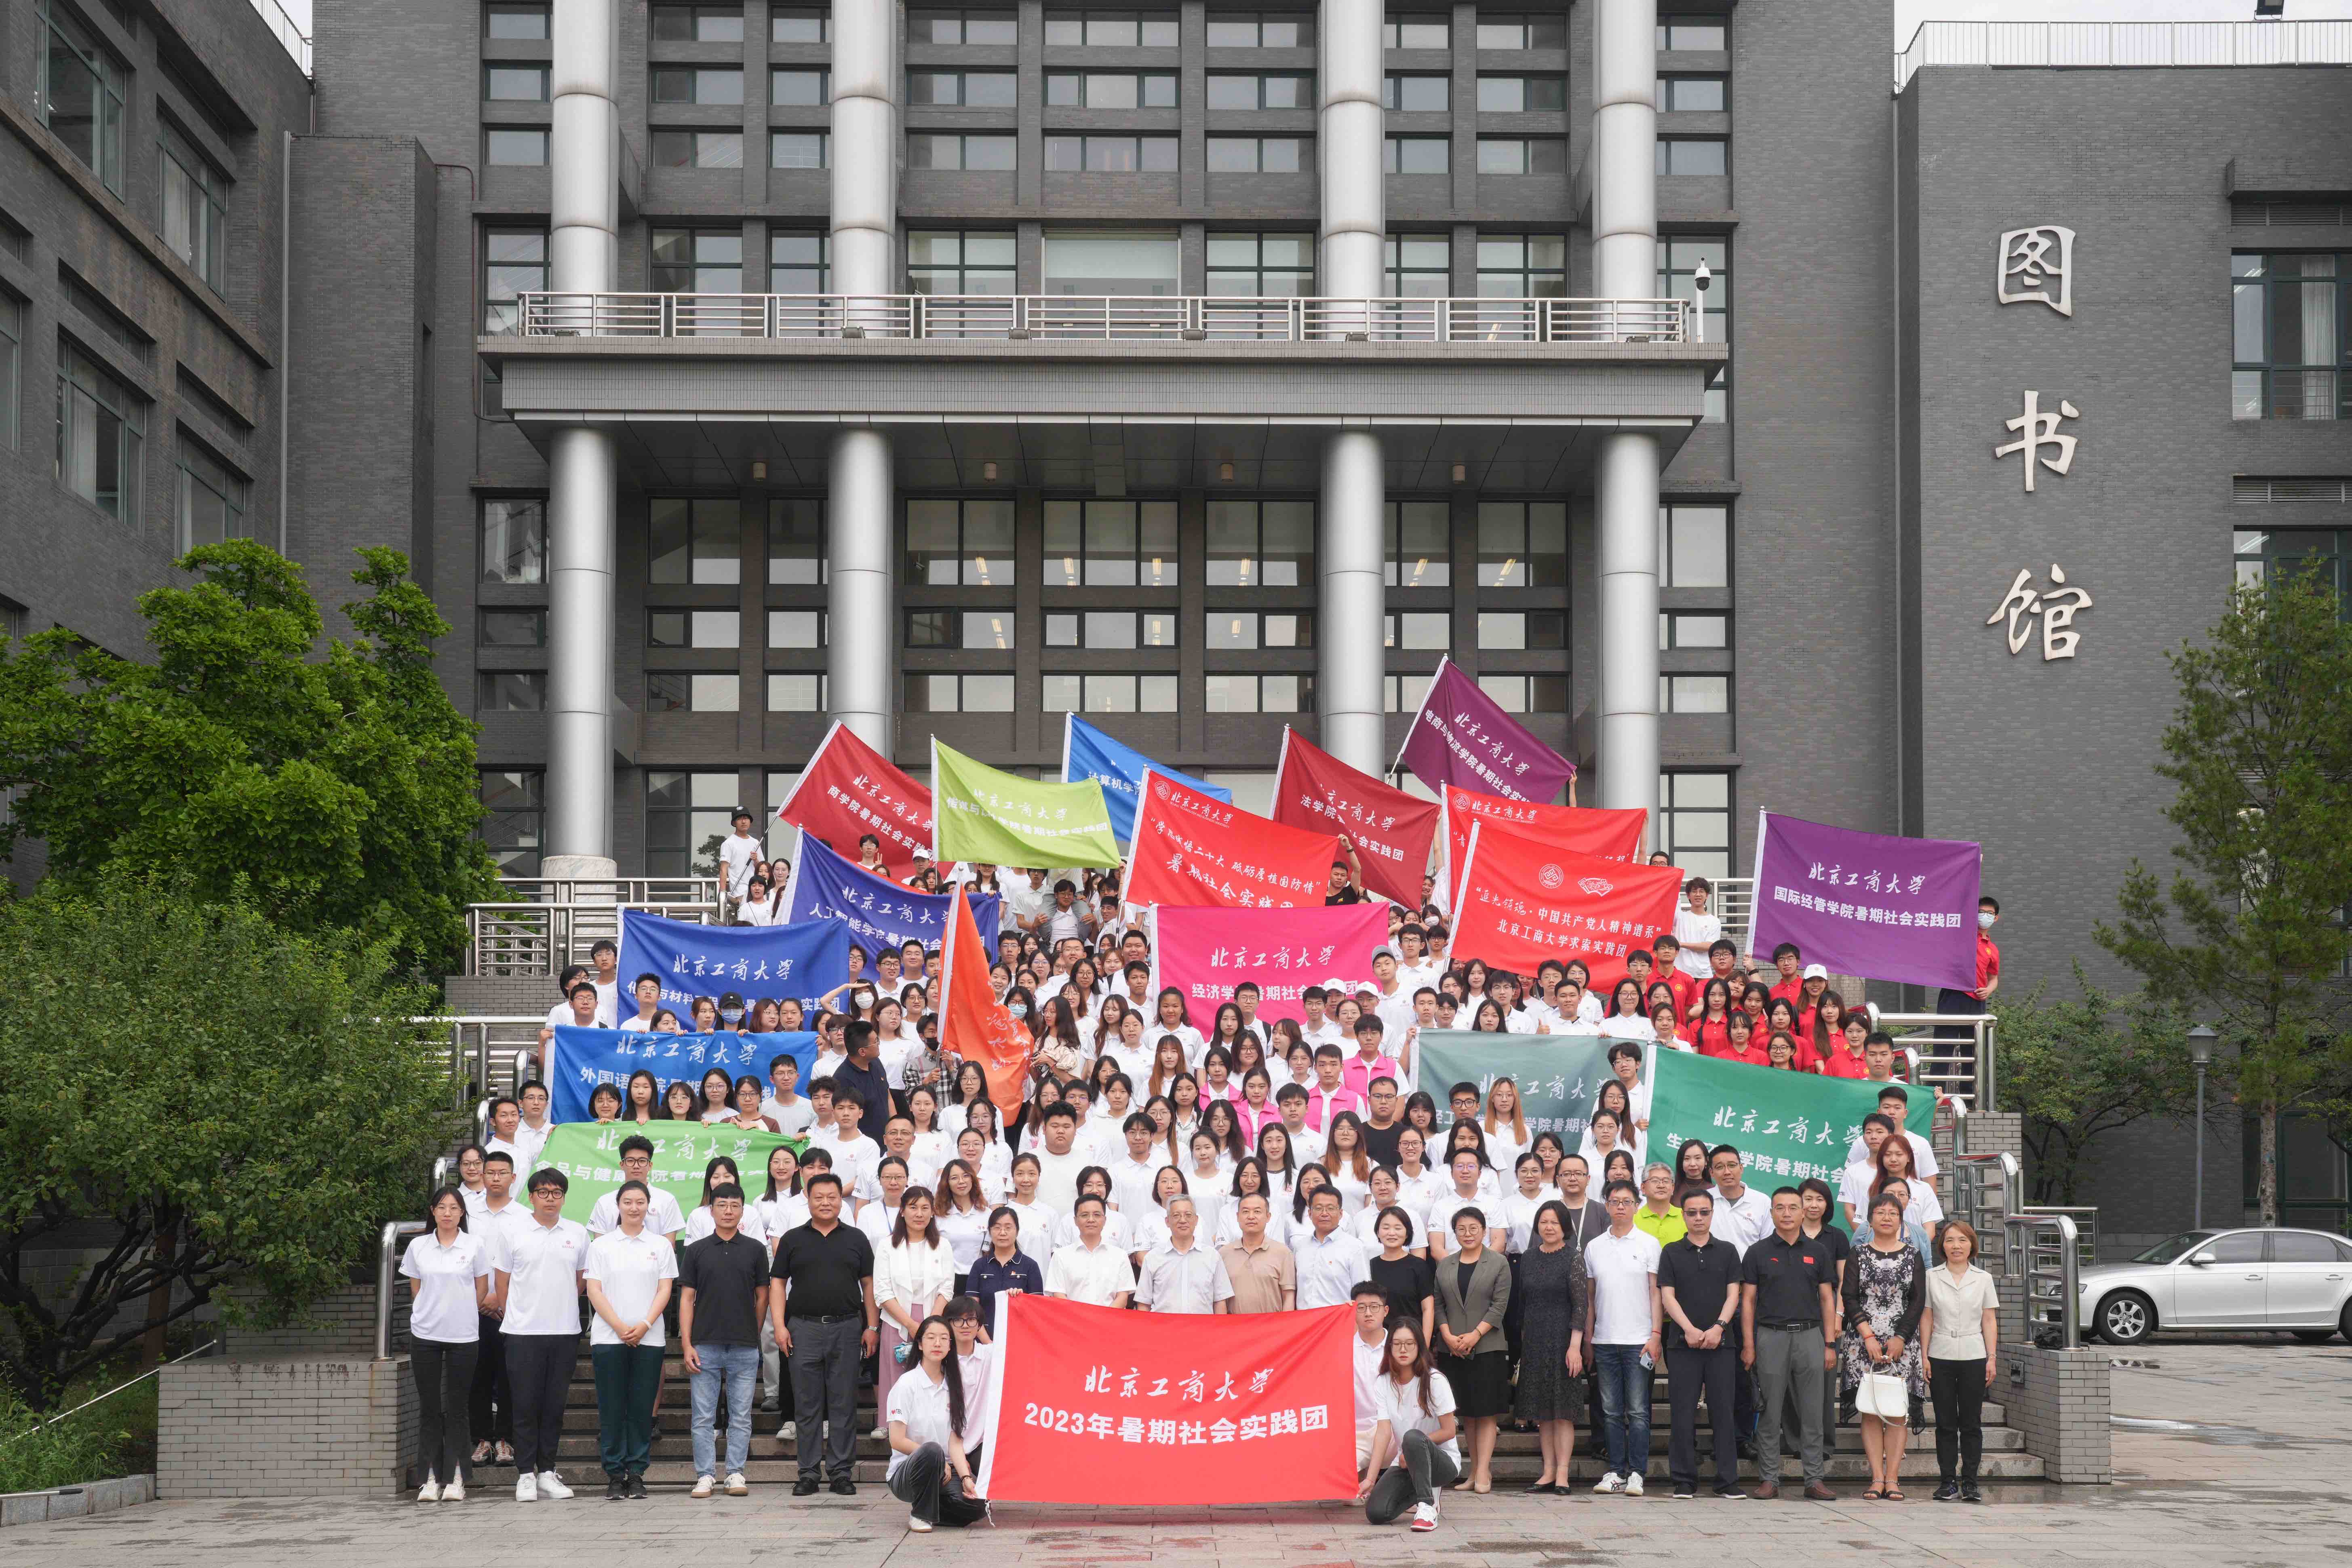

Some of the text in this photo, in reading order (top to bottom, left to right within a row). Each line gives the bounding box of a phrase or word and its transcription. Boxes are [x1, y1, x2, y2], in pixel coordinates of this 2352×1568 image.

[1987, 226, 2093, 661] 图书馆
[1425, 708, 1531, 804] 电商与物流学院暑期社会实
[1454, 711, 1530, 776] 北京工商大学
[974, 788, 1067, 821] 北京工商大学
[1171, 791, 1233, 824] 北京工商大学
[1320, 783, 1396, 831] 京工商大学
[1472, 800, 1537, 820] 北京工商大学
[1808, 862, 1926, 895] 北京工商大学
[1774, 885, 1961, 928] 国际经管学院暑期社会实践团
[1497, 919, 1627, 957] 北京工商大学求索实践团
[673, 953, 794, 981] 北京工商大学
[1211, 945, 1335, 970] 北京工商大学
[617, 1034, 757, 1065] 北京工商大学
[1479, 1073, 1612, 1100] 北工商大学
[596, 1129, 752, 1161] 北工商大学
[1085, 1364, 1274, 1404] 北京工商大学
[1025, 1403, 1328, 1445] 2023年暑期社会实践团
